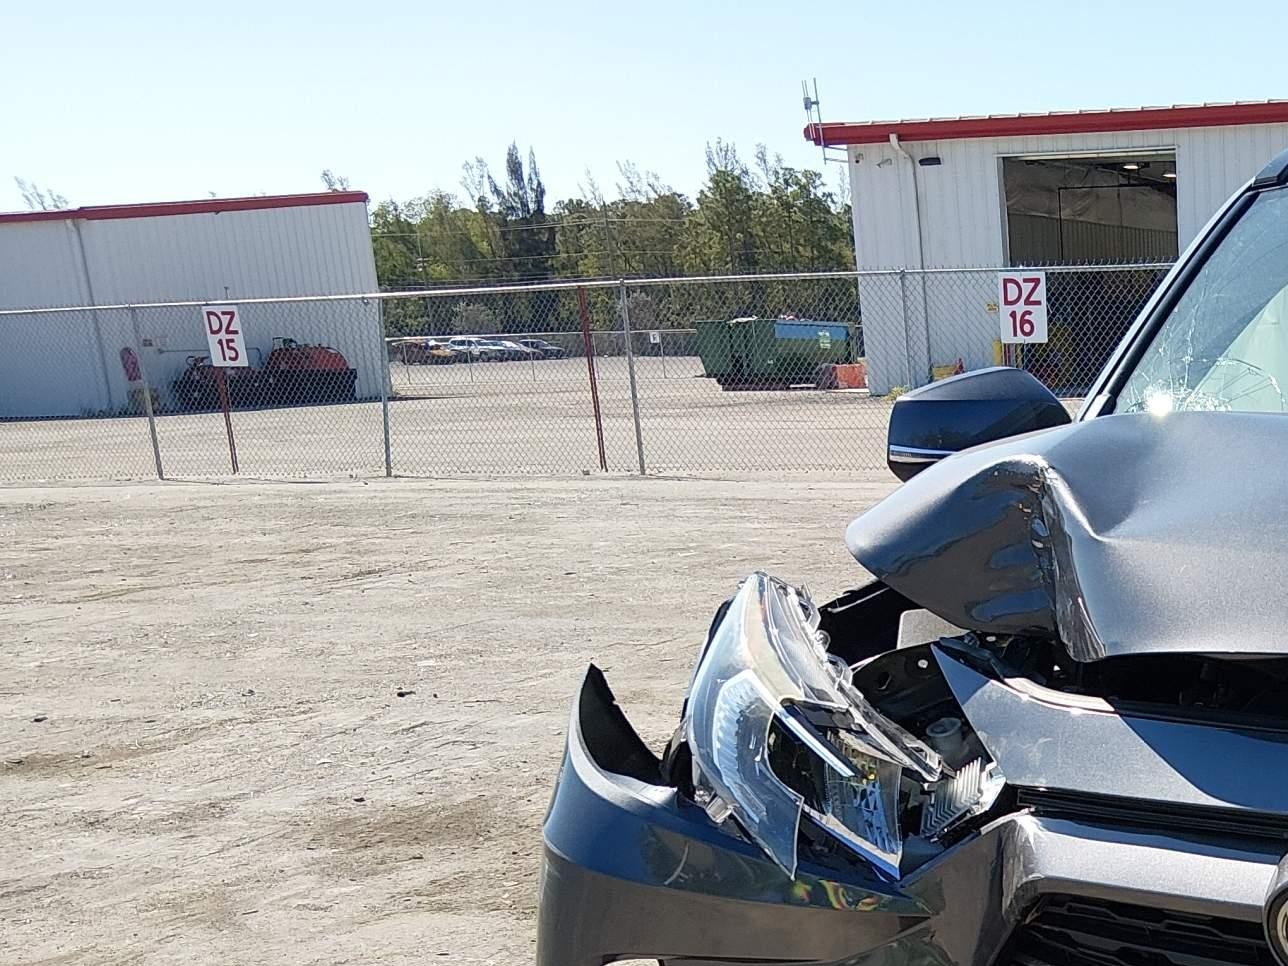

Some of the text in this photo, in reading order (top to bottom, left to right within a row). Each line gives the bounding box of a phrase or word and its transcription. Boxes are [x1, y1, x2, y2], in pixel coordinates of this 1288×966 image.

[1003, 277, 1042, 306] DZ
[206, 310, 239, 335] DZ
[1009, 309, 1035, 337] 16
[217, 338, 240, 362] 15
